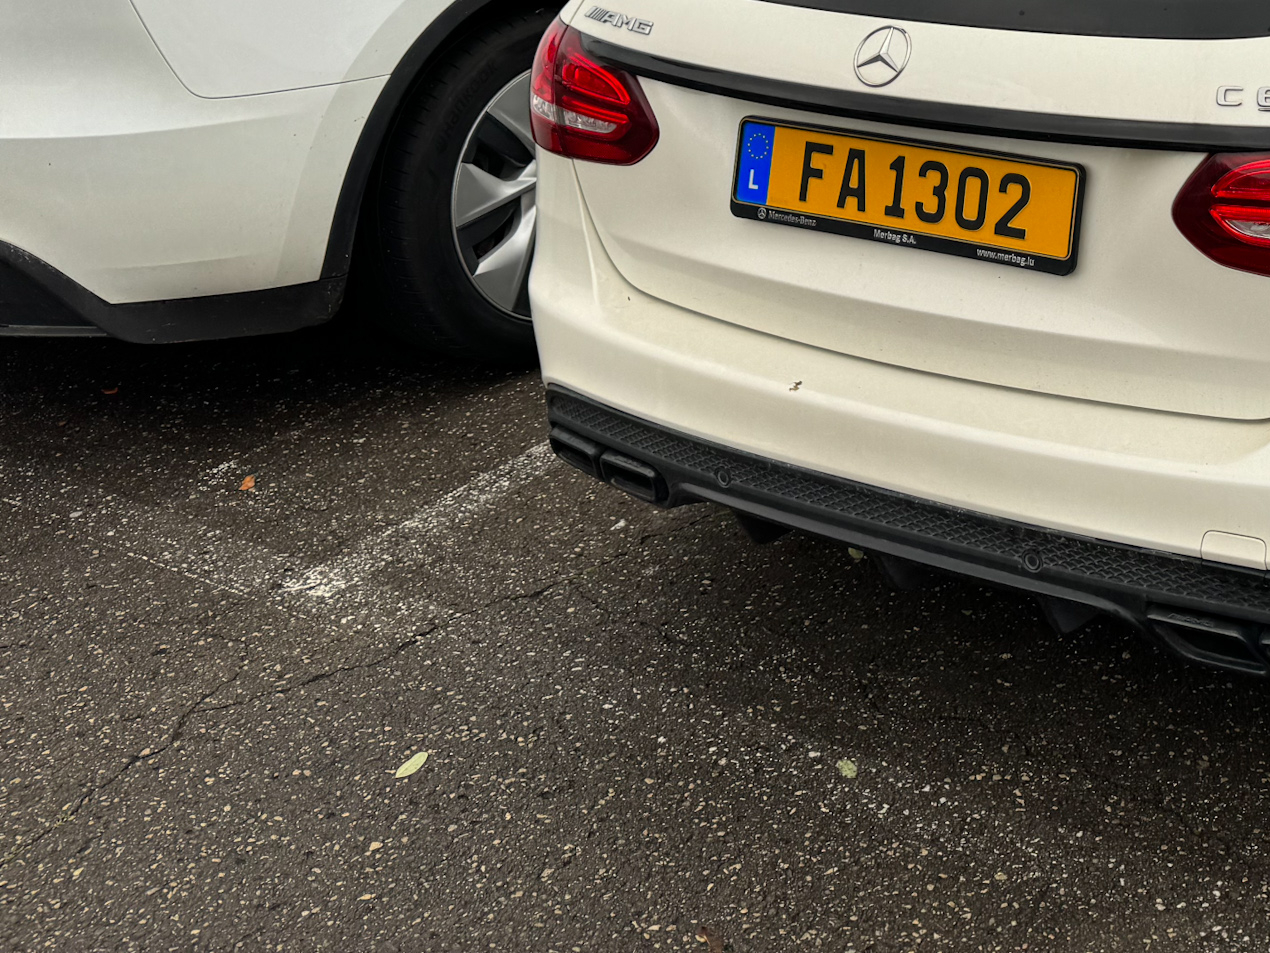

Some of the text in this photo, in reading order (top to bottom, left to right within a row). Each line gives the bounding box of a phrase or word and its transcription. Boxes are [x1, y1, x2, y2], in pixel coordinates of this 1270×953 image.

[600, 9, 654, 35] AMG
[748, 168, 758, 190] L
[768, 210, 817, 227] Mercedes-Benz
[873, 228, 917, 245] Merbag S.A.
[976, 248, 1034, 266] www.merbag.lu
